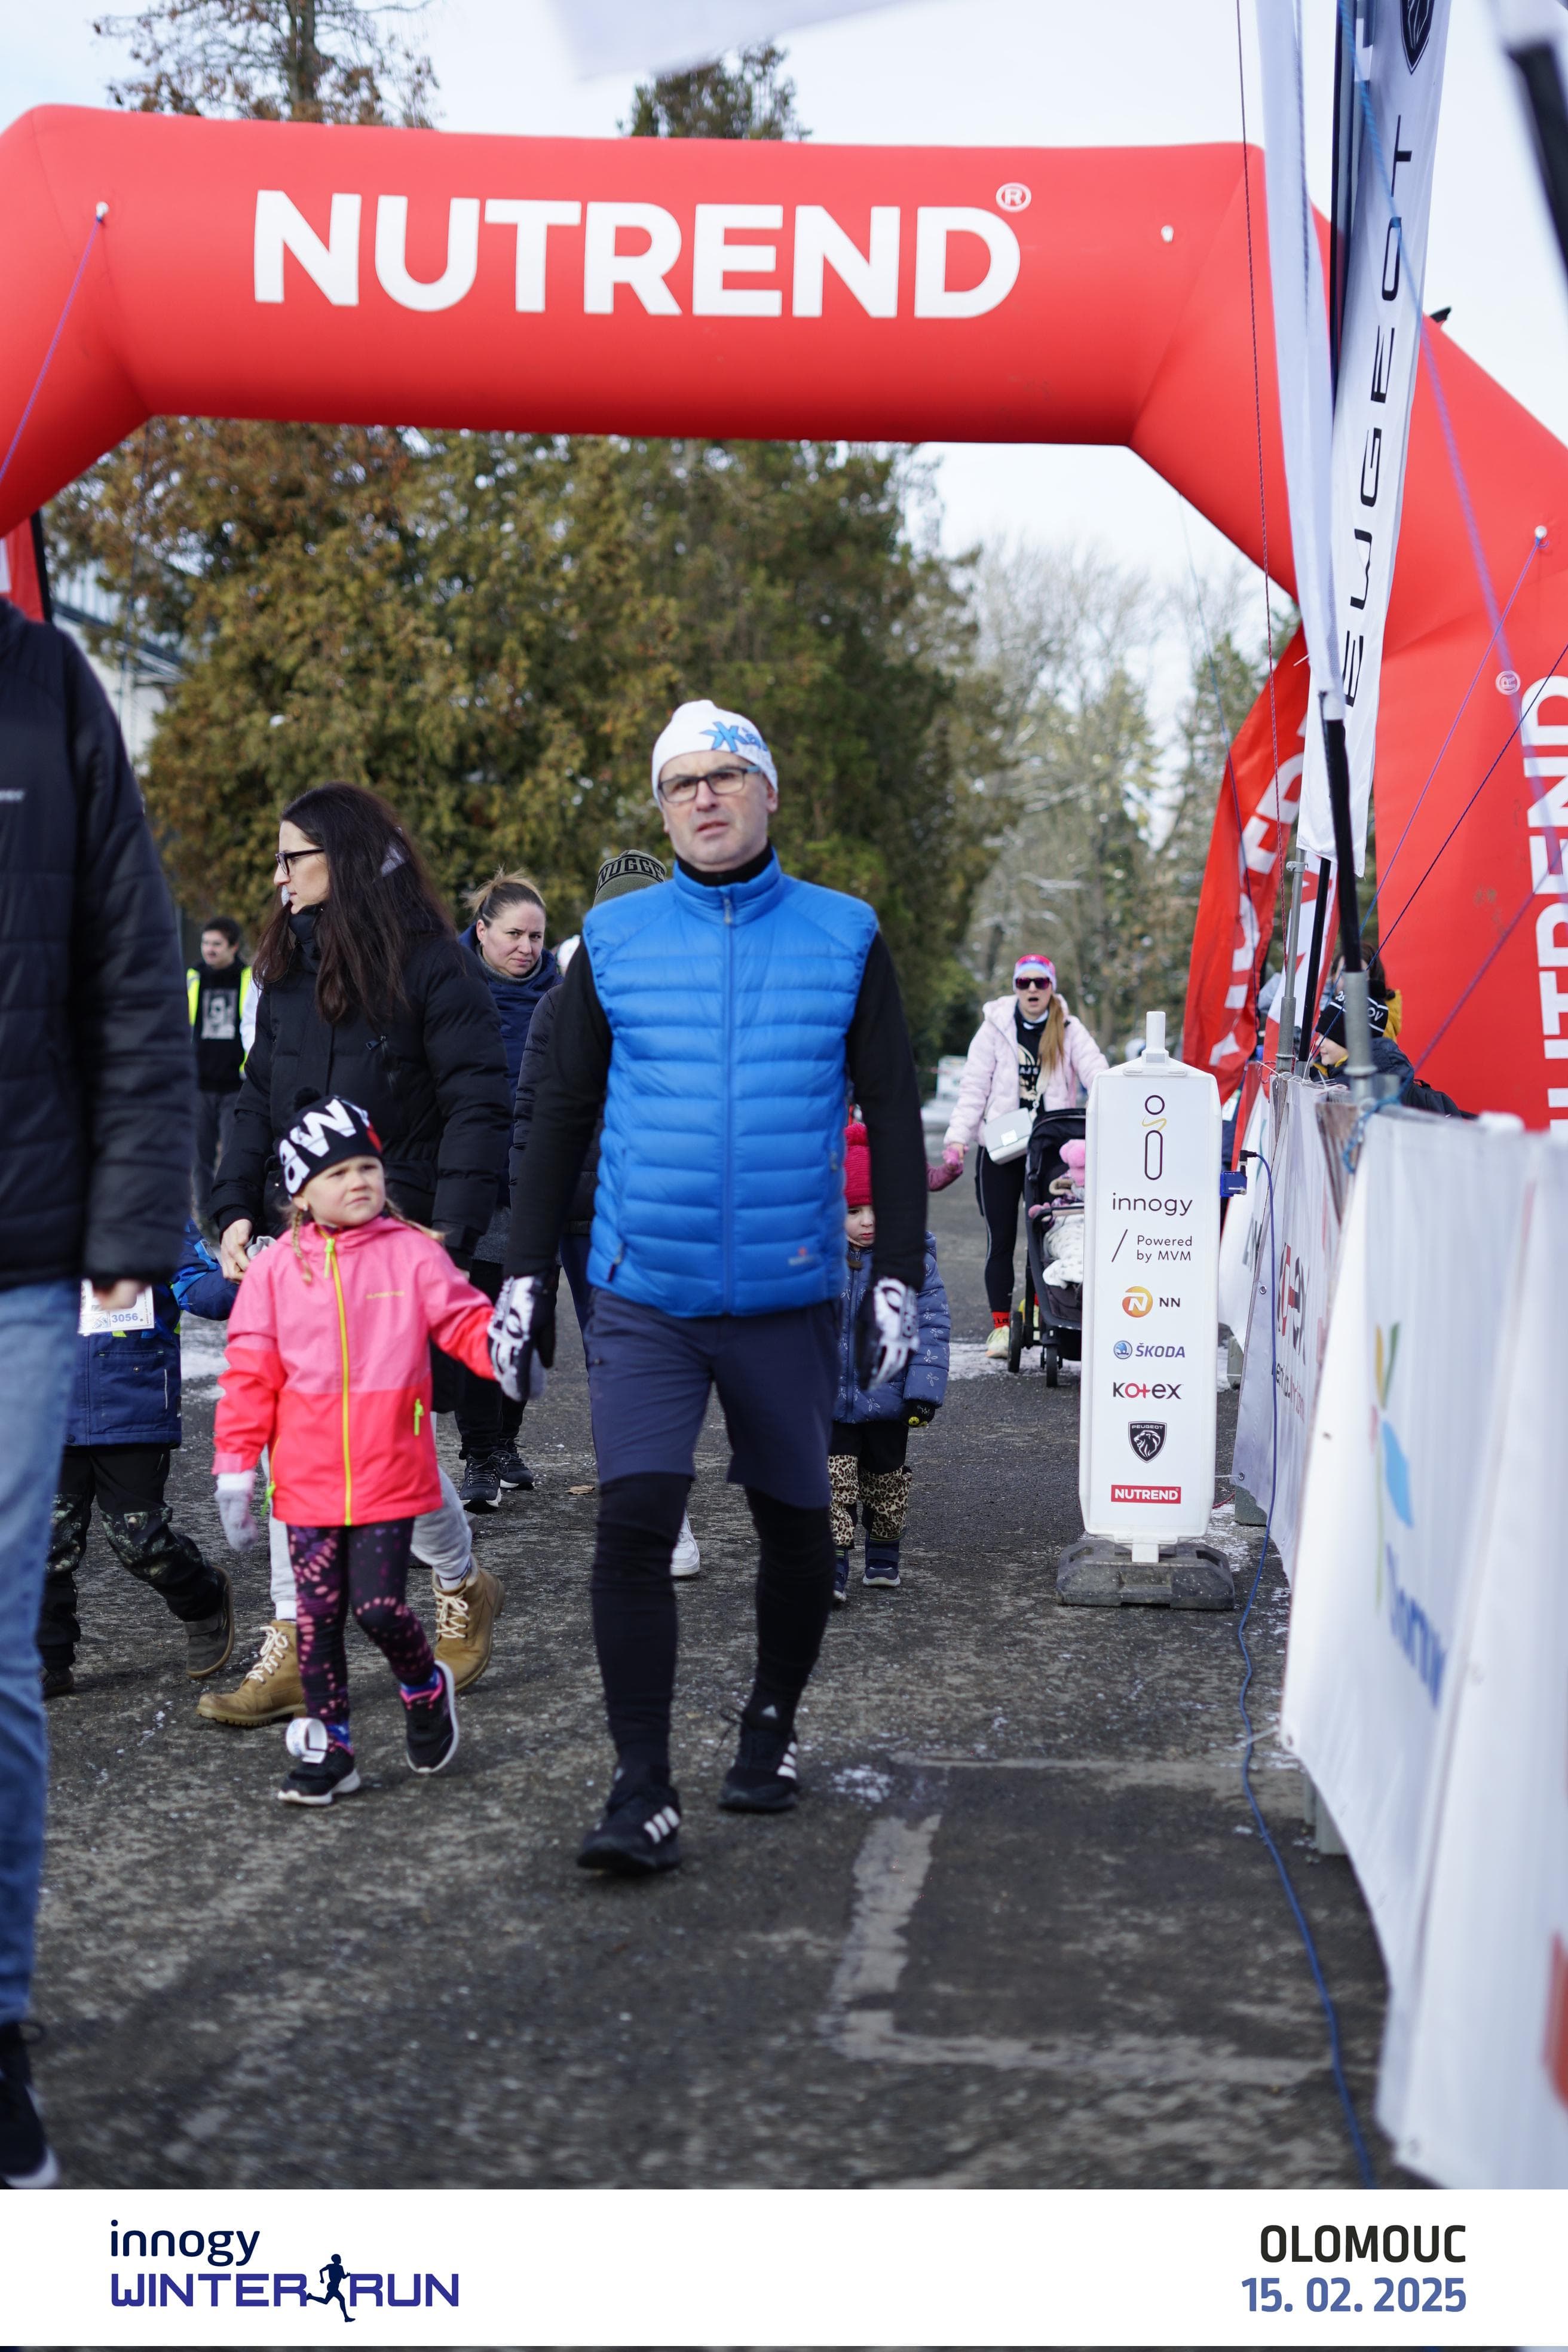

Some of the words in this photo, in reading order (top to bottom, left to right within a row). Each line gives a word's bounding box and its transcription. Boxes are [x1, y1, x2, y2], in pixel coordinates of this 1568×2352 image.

[1113, 1192, 1193, 1216] innogy
[1137, 1235, 1192, 1246] Powered
[1137, 1249, 1152, 1263] by
[1158, 1250, 1191, 1261] MVM
[1159, 1297, 1181, 1307] NN
[112, 1313, 138, 1322] 3056
[1135, 1343, 1186, 1358] ŠKODA
